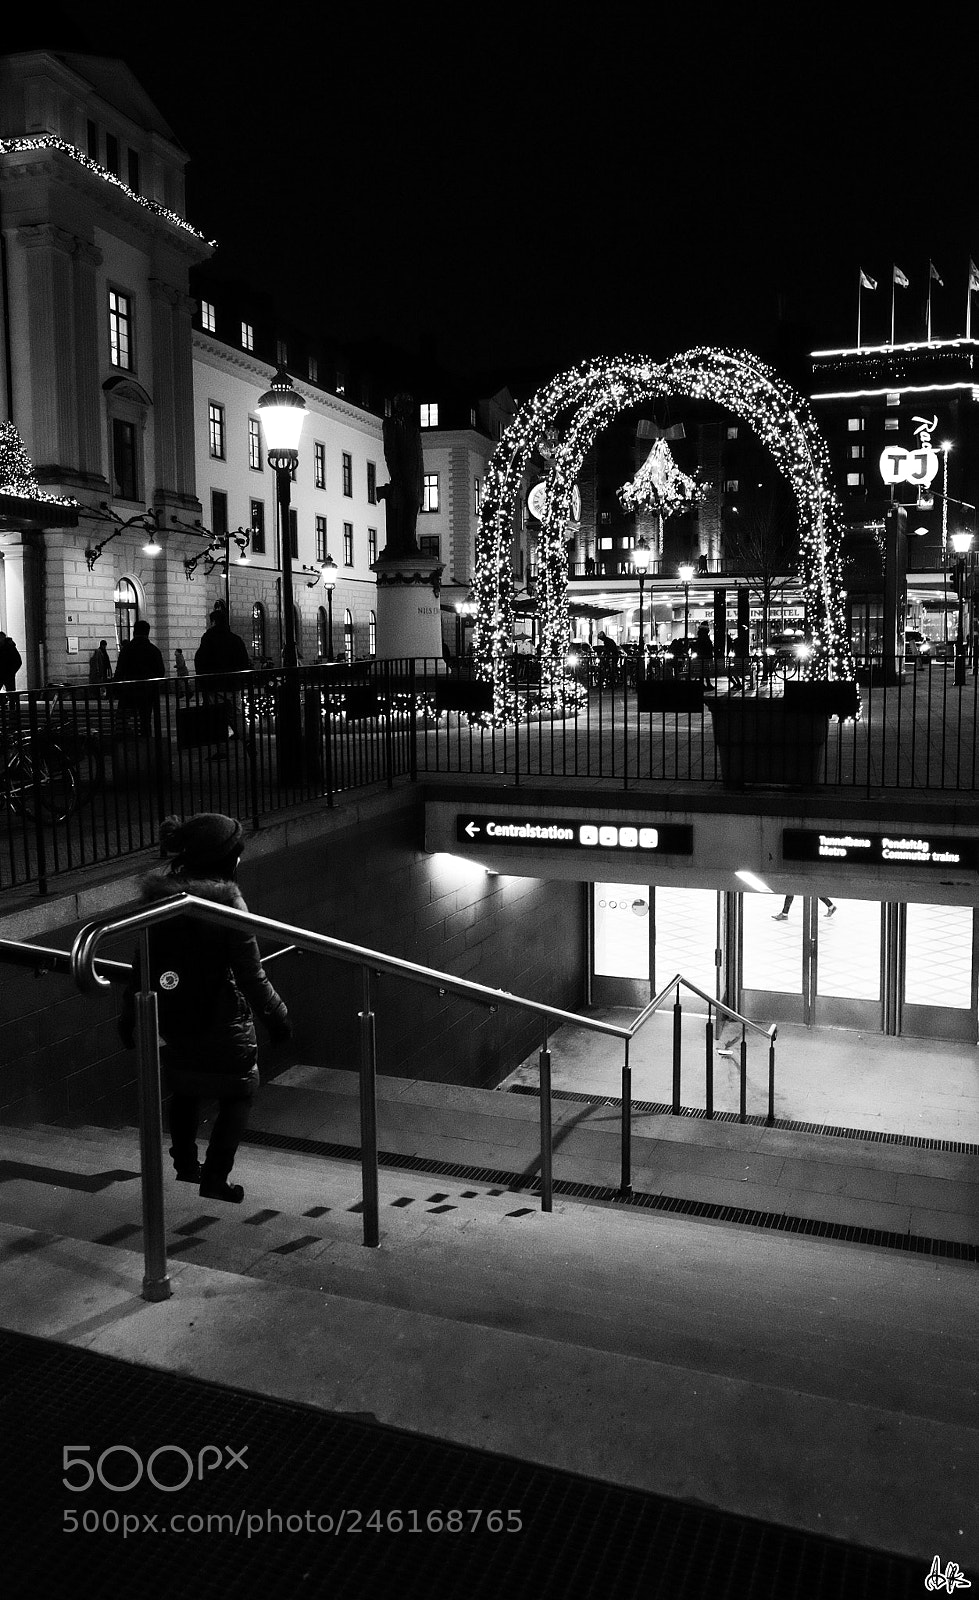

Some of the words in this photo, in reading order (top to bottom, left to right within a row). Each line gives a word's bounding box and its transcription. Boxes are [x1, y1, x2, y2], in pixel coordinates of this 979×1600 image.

[887, 454, 907, 476] T
[911, 453, 928, 480] J
[770, 608, 800, 617] HOTEL
[486, 822, 574, 840] Centralstation
[818, 835, 871, 848] Tunnelbana
[881, 837, 930, 852] Pendeltåg
[818, 845, 847, 857] Metro
[881, 848, 931, 861] Commuter
[932, 851, 960, 863] trains
